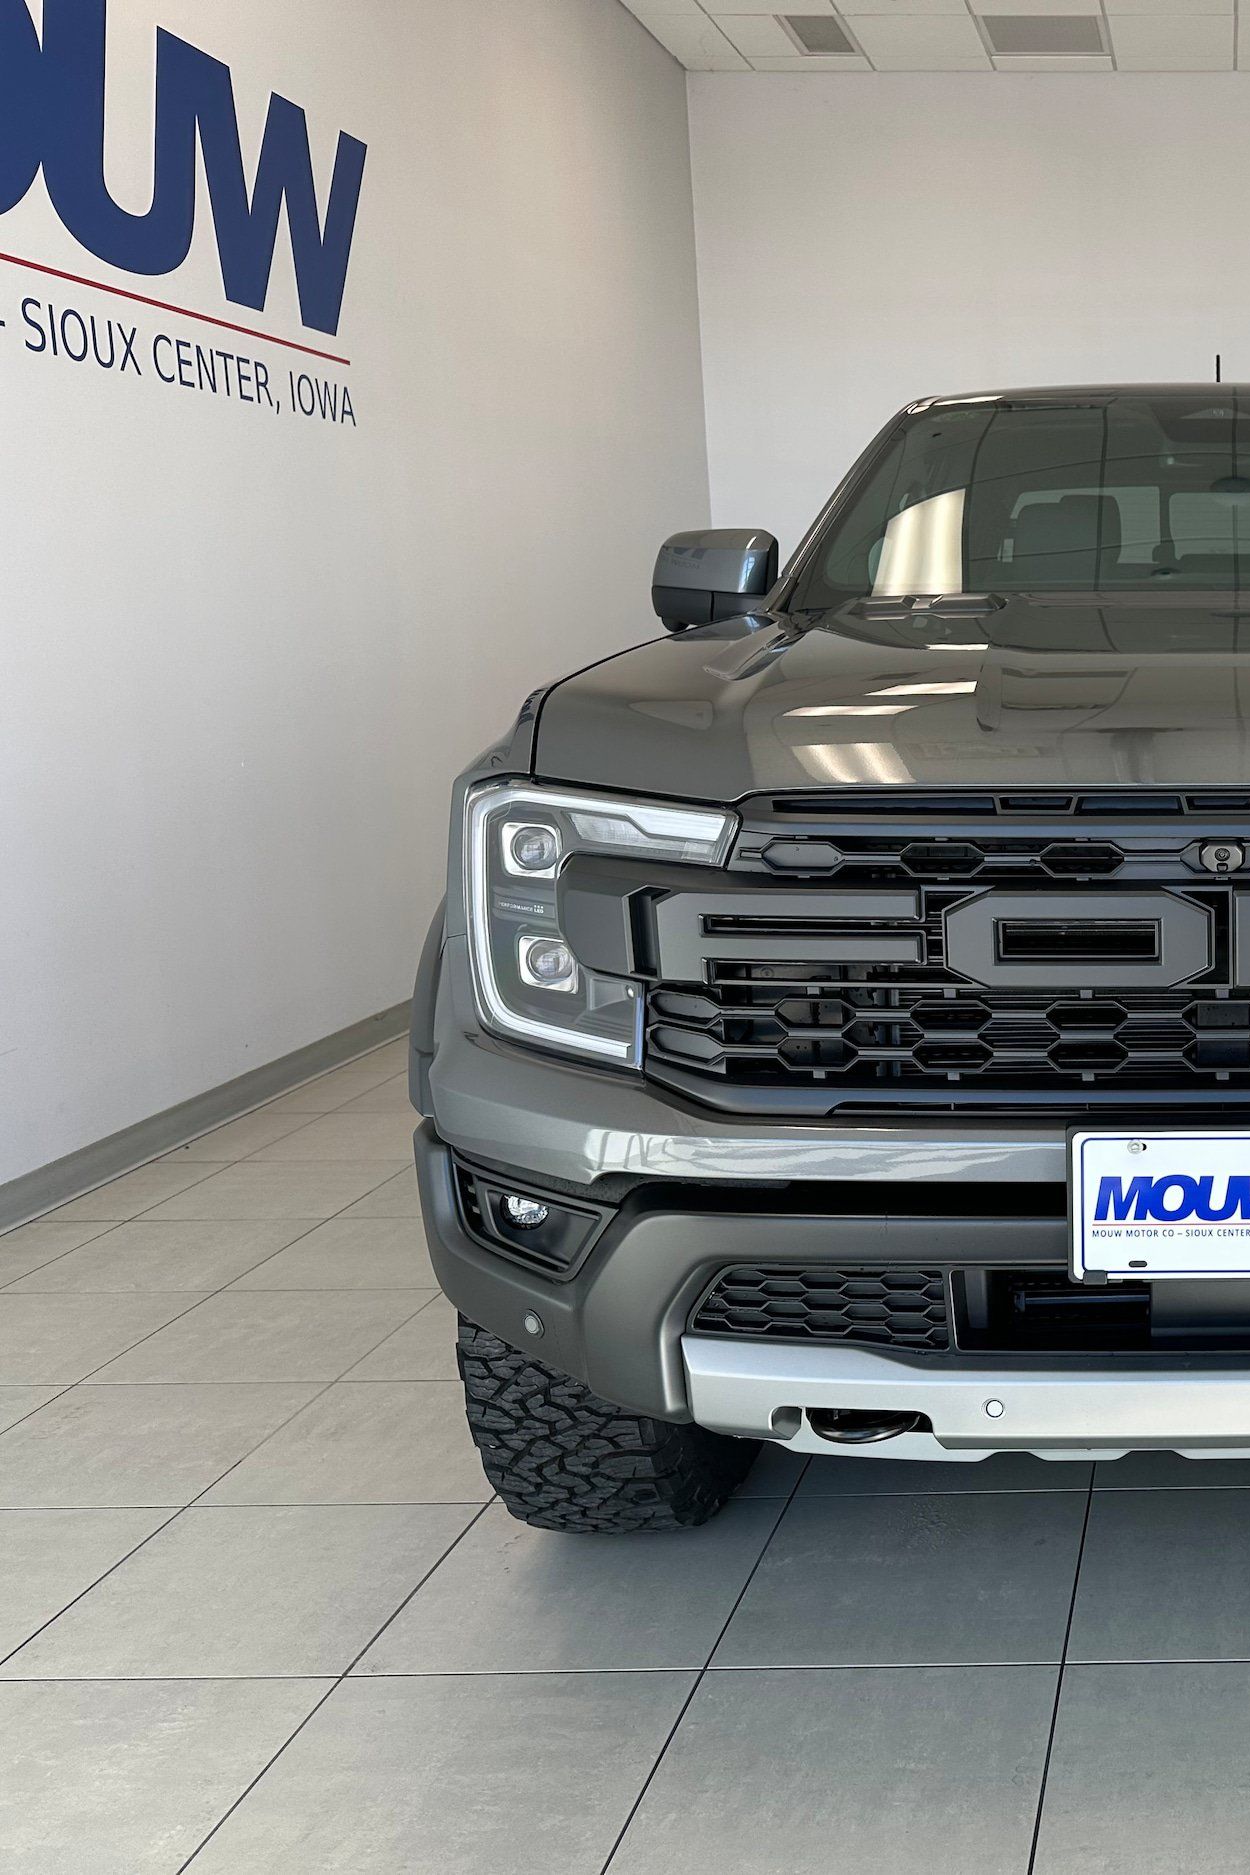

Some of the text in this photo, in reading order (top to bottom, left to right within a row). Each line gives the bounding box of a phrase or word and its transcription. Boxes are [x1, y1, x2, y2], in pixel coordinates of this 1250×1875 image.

[21, 297, 357, 427] SIOUX CENTER, IOWA
[1092, 1229, 1122, 1237] MOUW
[1125, 1229, 1159, 1237] MOTOR
[1162, 1229, 1174, 1237] CO
[1185, 1229, 1214, 1237] SIOUX
